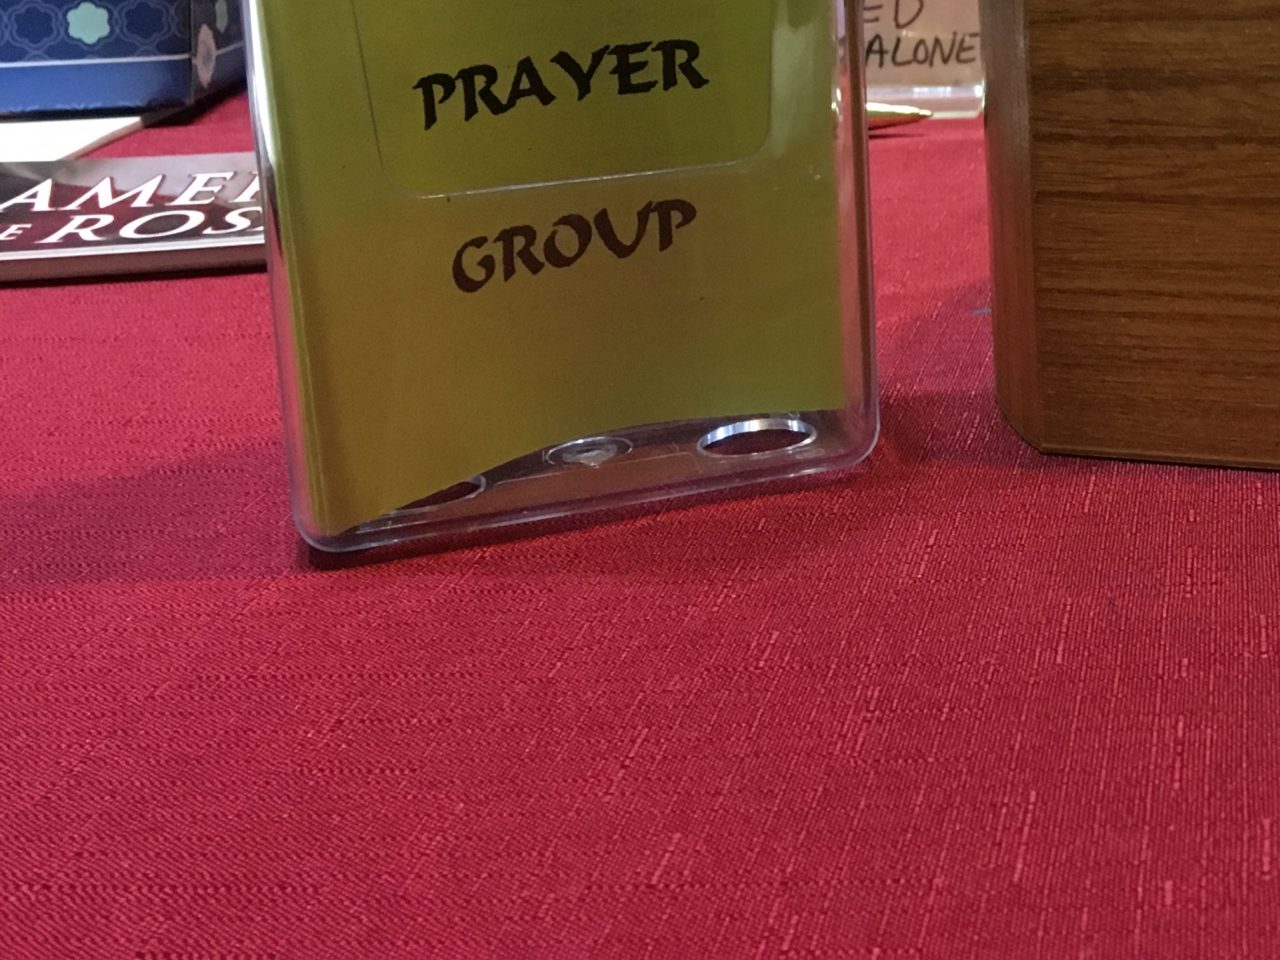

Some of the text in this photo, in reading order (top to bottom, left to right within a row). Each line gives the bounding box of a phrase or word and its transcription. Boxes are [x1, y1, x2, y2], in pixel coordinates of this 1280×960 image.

[866, 31, 980, 68] ALONE
[413, 38, 708, 130] PRAYER
[34, 206, 264, 244] ROS
[452, 199, 696, 293] GROUP
